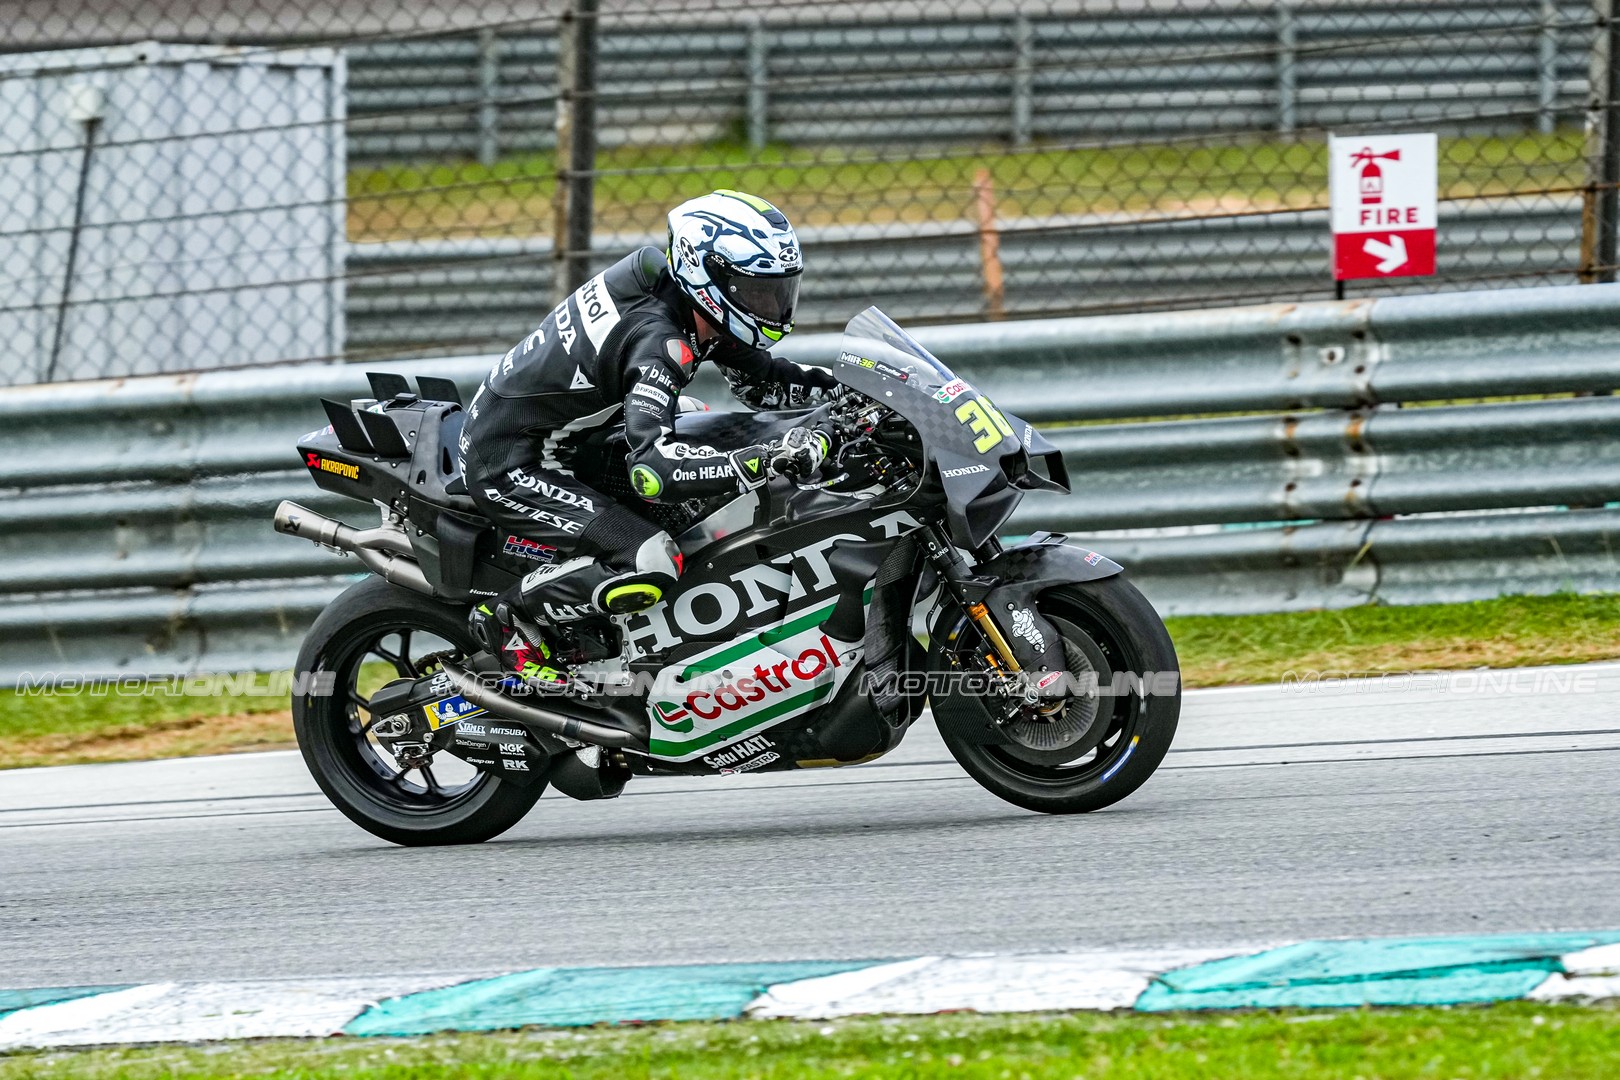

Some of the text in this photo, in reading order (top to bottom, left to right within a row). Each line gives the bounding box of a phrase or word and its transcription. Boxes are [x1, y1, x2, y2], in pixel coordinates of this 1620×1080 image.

[1360, 208, 1418, 225] FIRE
[581, 279, 609, 324] strol
[672, 464, 738, 482] One HEAR
[942, 465, 990, 478] HONDA
[507, 467, 596, 513] HONDA
[503, 535, 558, 561] HRC
[469, 588, 499, 597] Honda
[685, 635, 841, 720] Castrol
[490, 728, 527, 737] MITSUBA
[499, 743, 525, 753] NGK
[703, 735, 776, 769] Satu HATI.
[503, 759, 529, 769] RK
